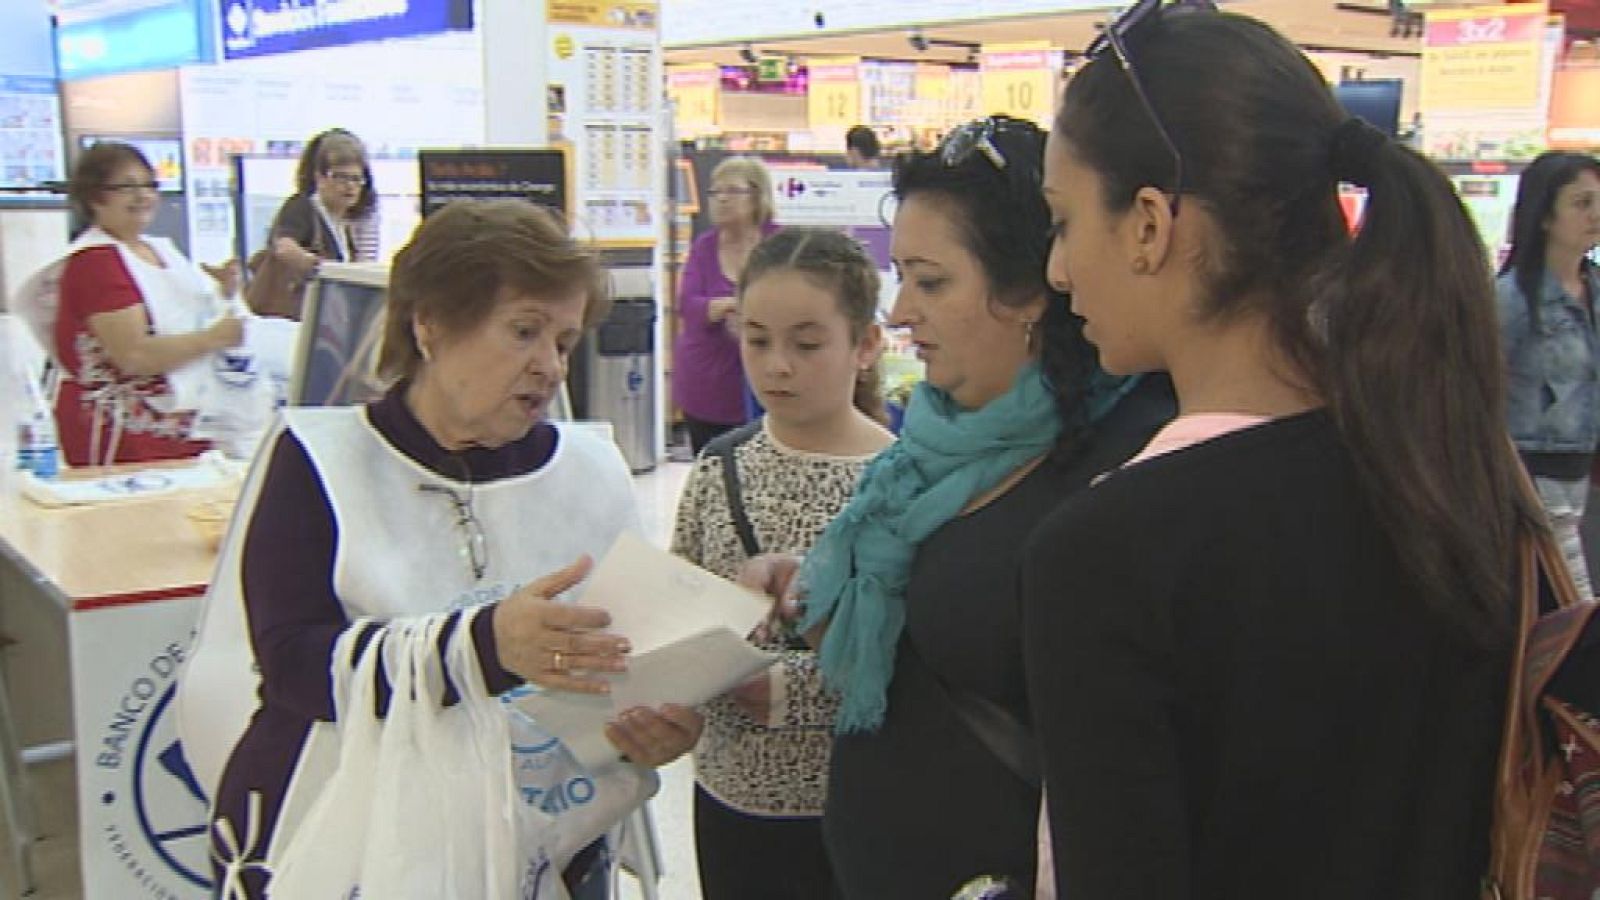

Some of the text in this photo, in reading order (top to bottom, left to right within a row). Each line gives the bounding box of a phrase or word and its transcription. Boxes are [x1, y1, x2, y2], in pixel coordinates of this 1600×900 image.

[1458, 18, 1506, 43] 3x2
[828, 92, 847, 117] 12
[1006, 81, 1034, 110] 10
[96, 641, 185, 769] BANCO DE
